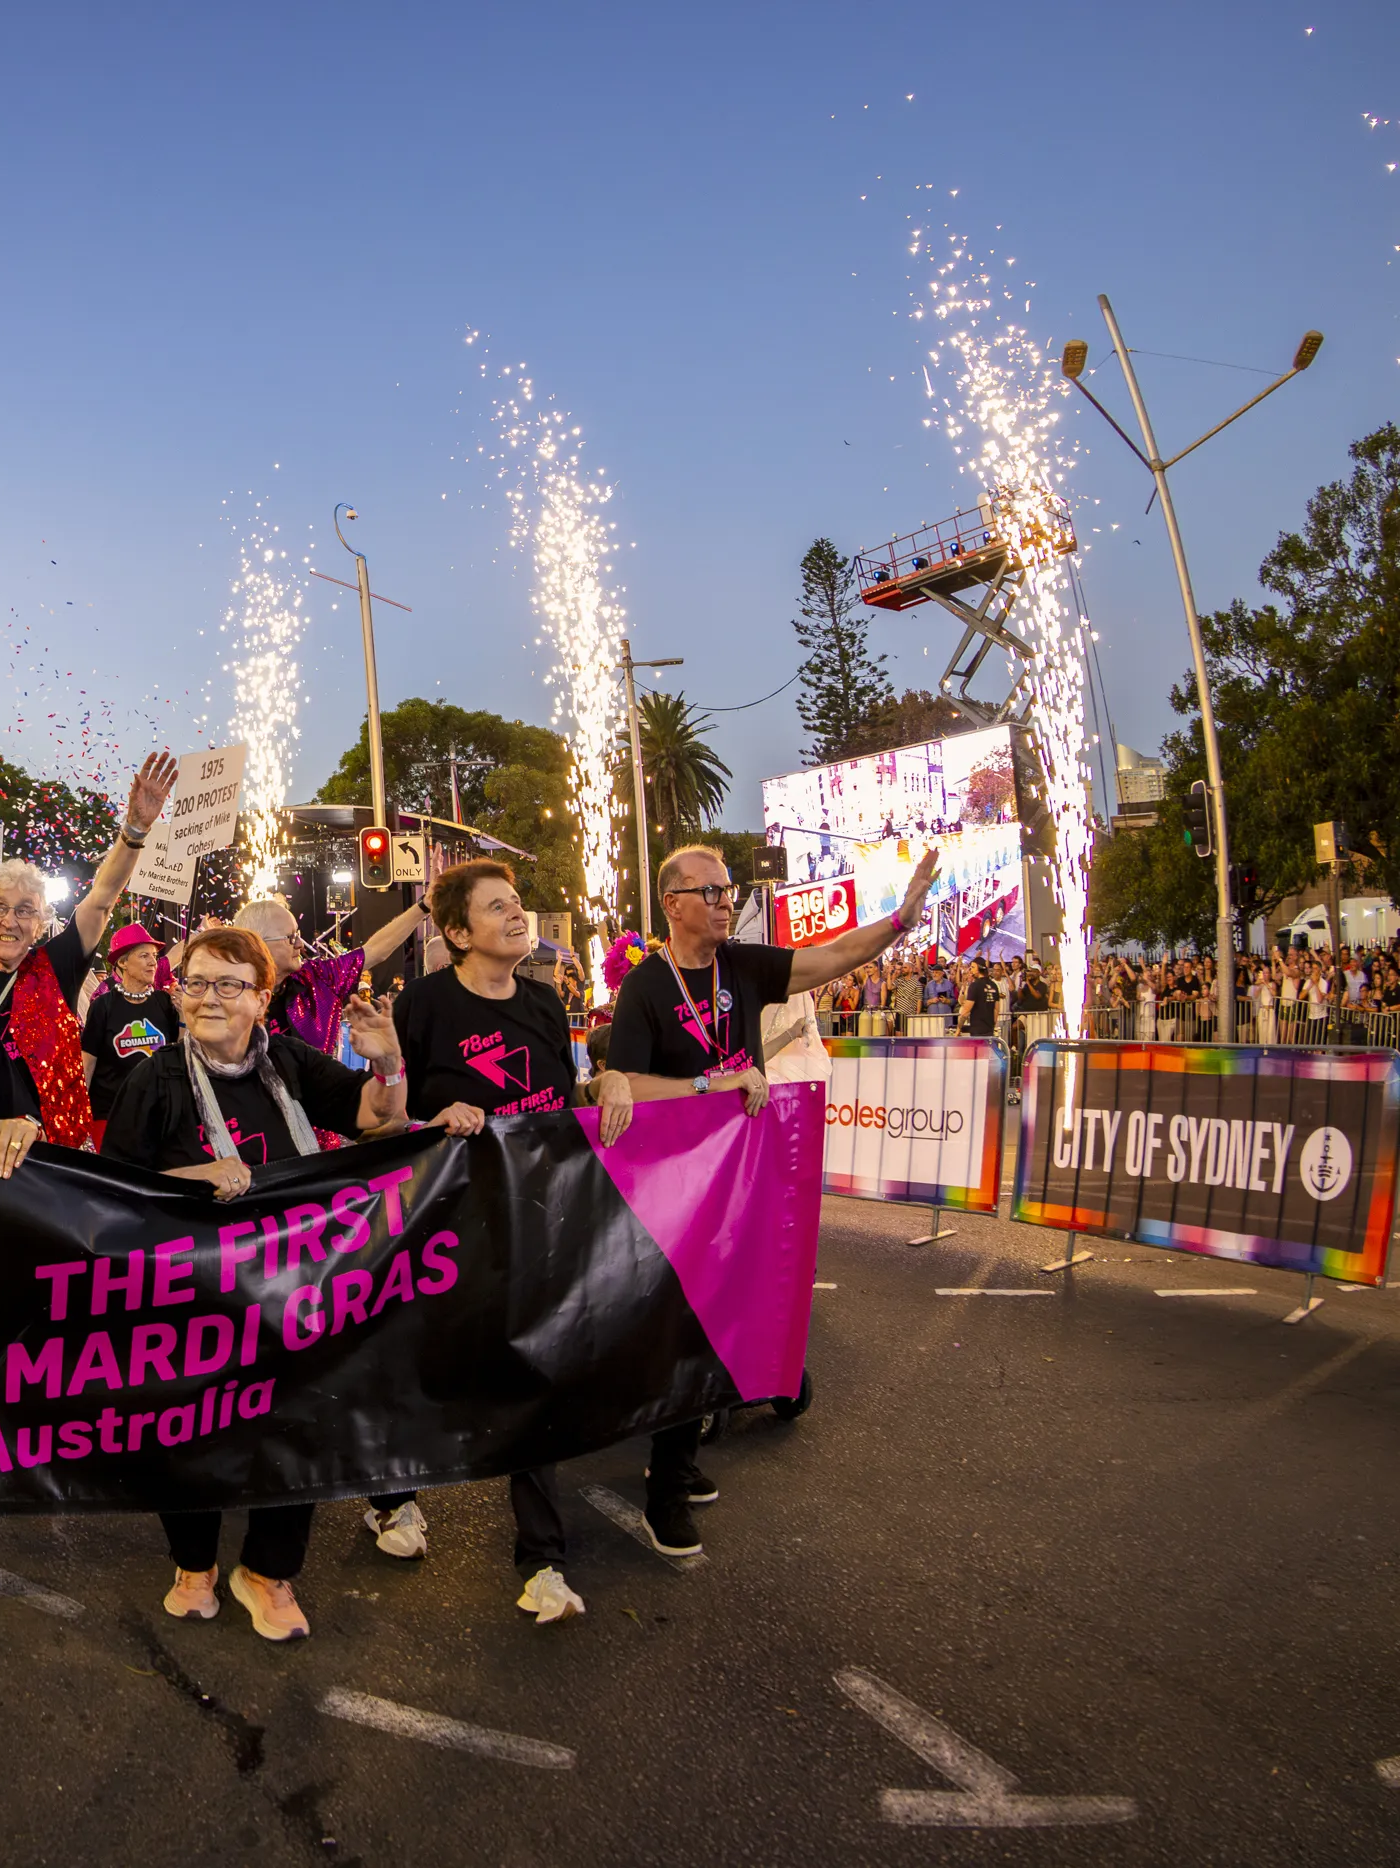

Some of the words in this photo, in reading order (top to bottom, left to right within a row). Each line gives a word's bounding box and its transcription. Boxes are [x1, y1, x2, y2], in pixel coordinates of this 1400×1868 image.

[200, 758, 224, 780] 1975
[173, 795, 194, 818] 200
[197, 782, 238, 811] PROTEST
[174, 819, 203, 840] sacking
[205, 814, 214, 830] of
[214, 811, 231, 827] Mike
[187, 838, 216, 857] Clohesy
[139, 868, 147, 878] by
[147, 869, 167, 882] Marist
[166, 874, 189, 887] Brothers
[396, 868, 422, 876] ONLY
[148, 884, 175, 896] Eastwood
[787, 890, 824, 920] BIG
[790, 913, 826, 942] BUS
[120, 1036, 159, 1048] EQUALITY
[459, 1031, 503, 1057] 78ers
[493, 1101, 519, 1116] THE
[520, 1086, 554, 1112] FIRST
[1053, 1107, 1122, 1172] CITY
[1125, 1110, 1163, 1177] OF
[1166, 1114, 1295, 1194] SYDNEY
[34, 1235, 196, 1321] THE
[217, 1165, 413, 1293] FIRST
[5, 1303, 261, 1403] MARDI
[282, 1230, 460, 1352] GRAS
